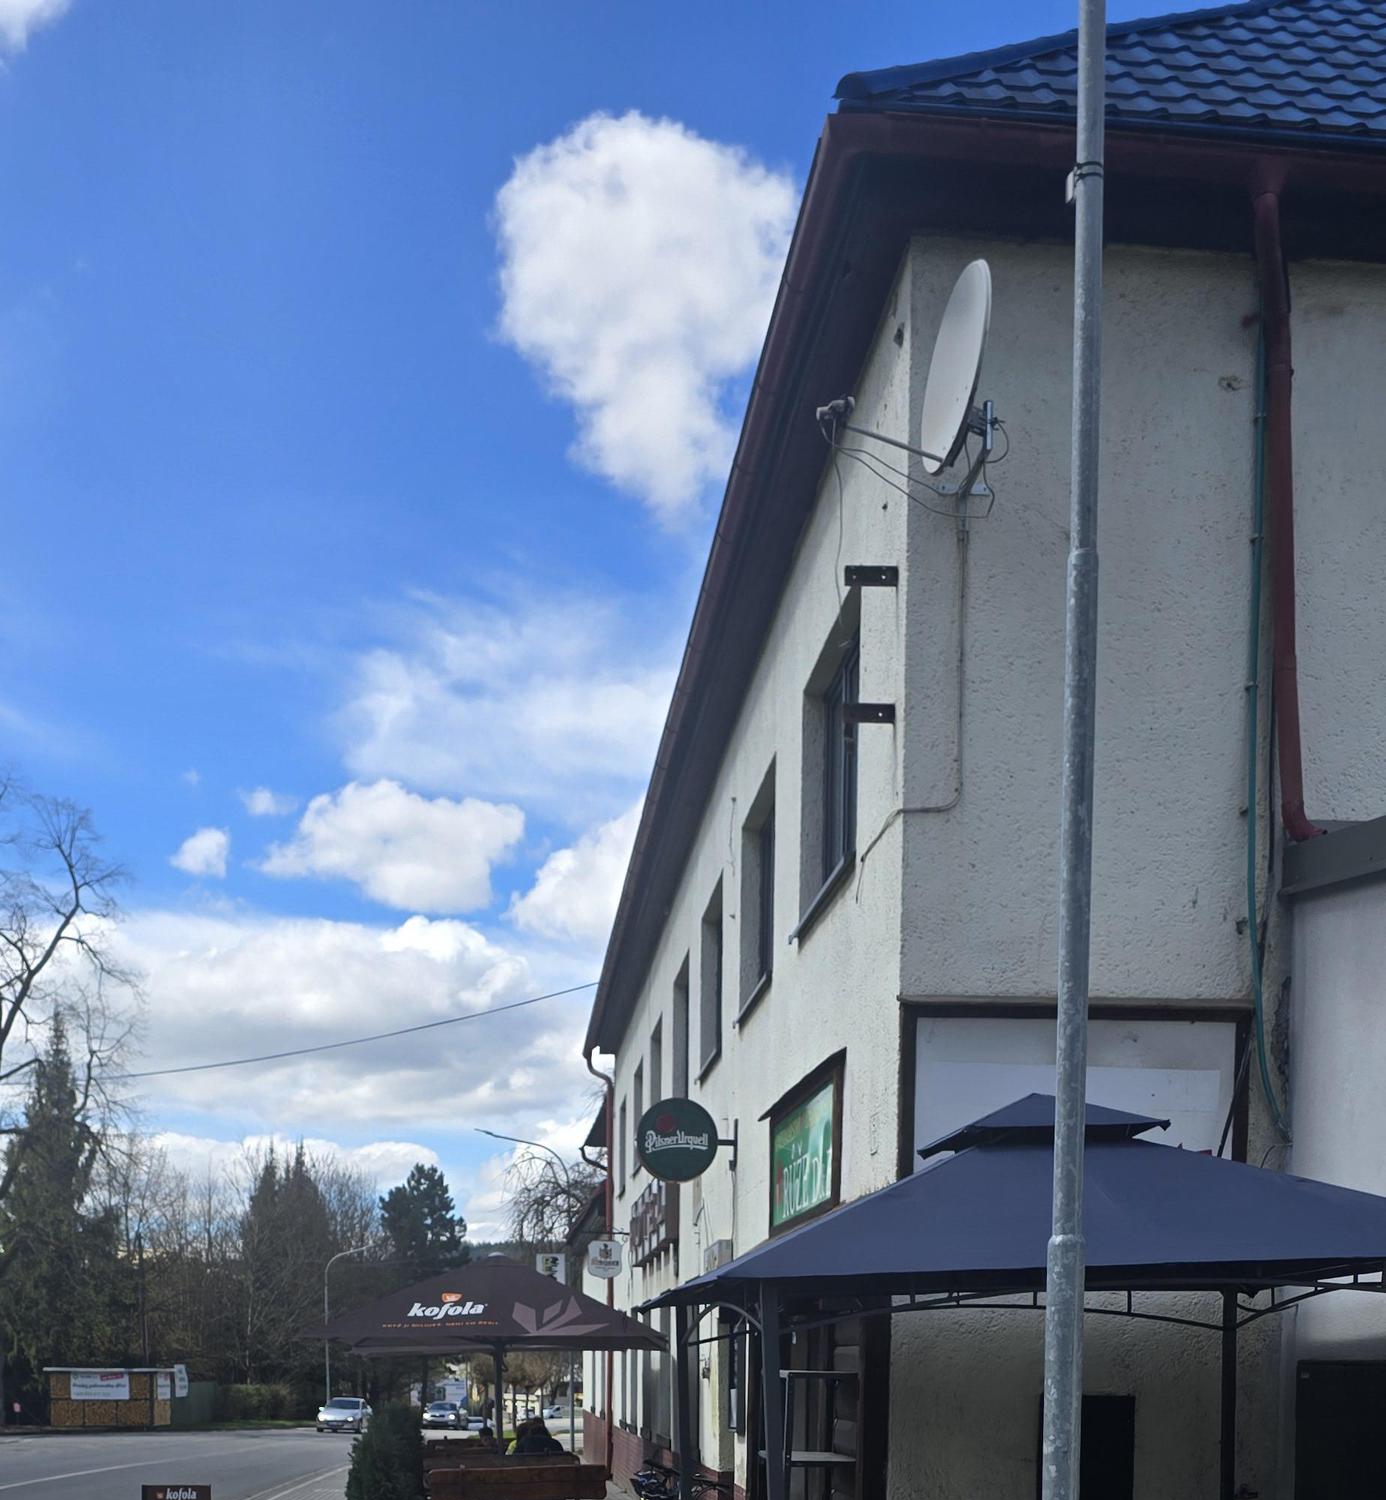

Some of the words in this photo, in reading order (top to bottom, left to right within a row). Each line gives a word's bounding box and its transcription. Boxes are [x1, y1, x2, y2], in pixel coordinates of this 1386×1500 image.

[645, 1130, 678, 1153] Pilsner
[676, 1129, 708, 1150] Urquell
[407, 1302, 484, 1320] kofola
